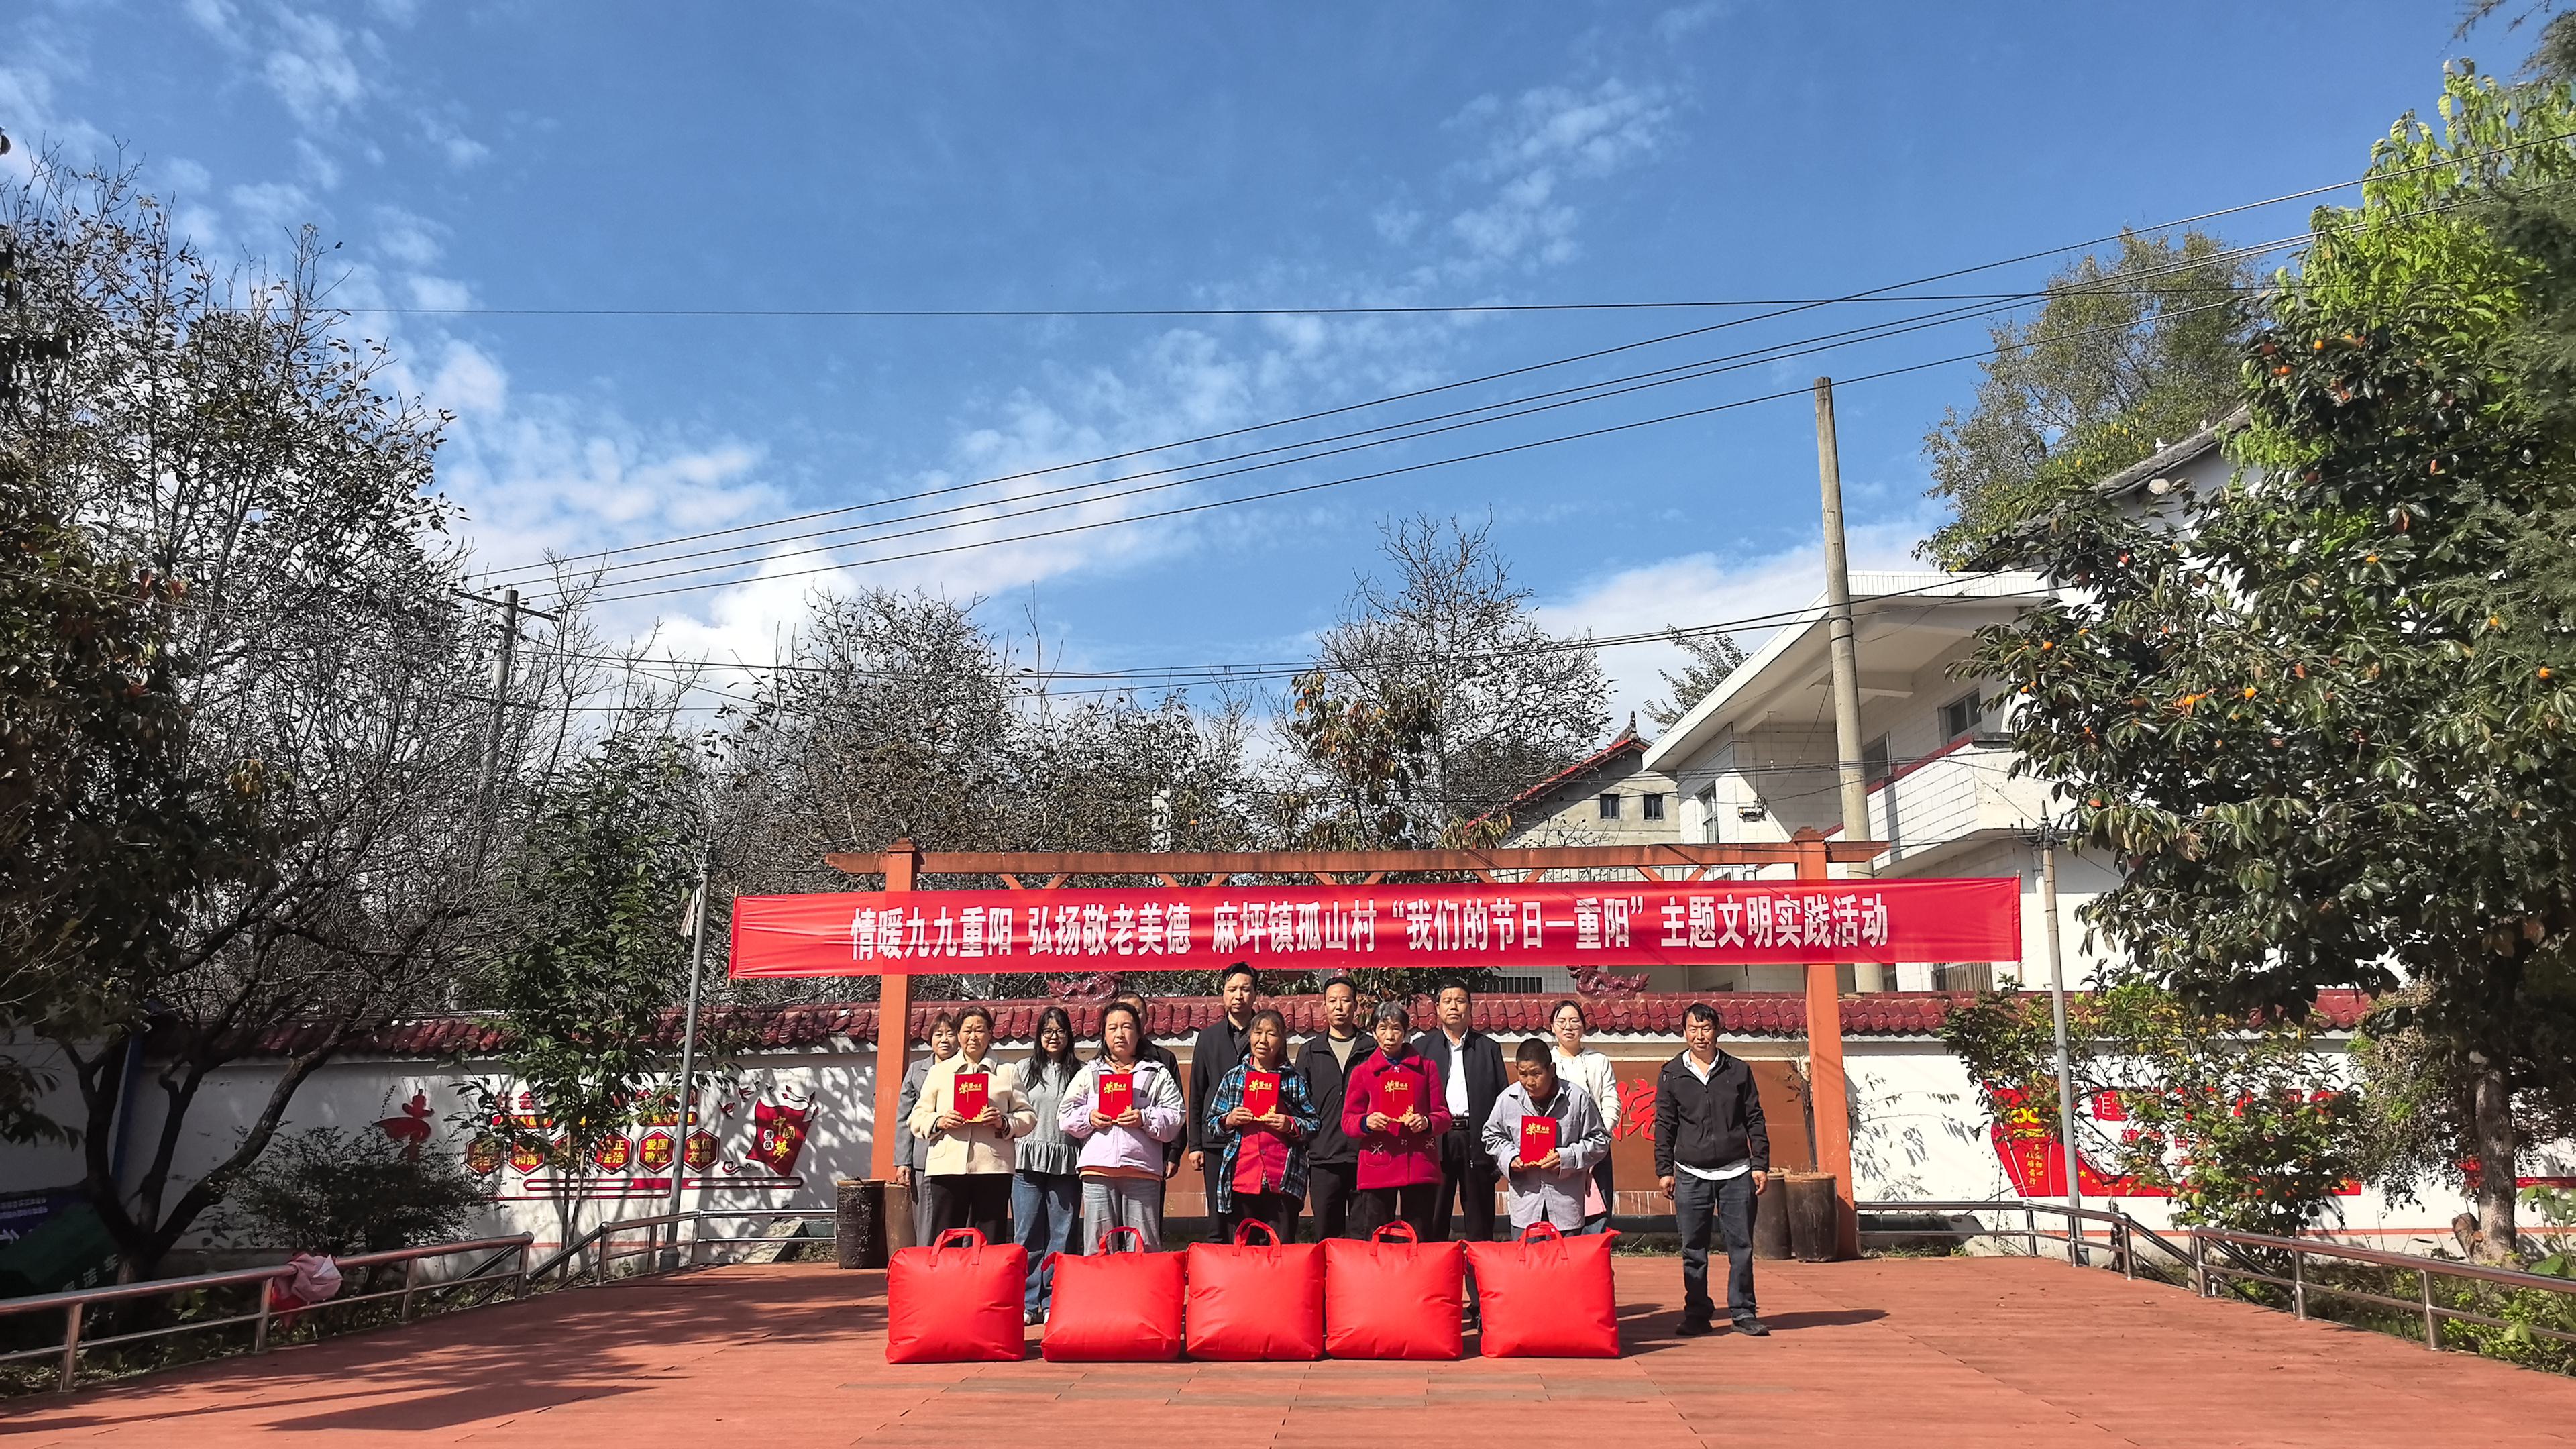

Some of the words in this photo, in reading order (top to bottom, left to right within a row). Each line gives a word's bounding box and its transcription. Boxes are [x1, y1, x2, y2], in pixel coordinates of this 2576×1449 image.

[850, 906, 1014, 961] 情暖九九重阳
[1028, 902, 1190, 956] 弘扬敬老美德
[1212, 900, 1376, 953] 麻坪镇孤山村
[1661, 893, 1887, 947] 主题文明实践活动
[1612, 1078, 1657, 1141] 院
[646, 1139, 669, 1150] 爱国
[689, 1139, 712, 1150] 诚信
[515, 1154, 537, 1165] 和谐
[600, 1152, 625, 1163] 法治
[645, 1152, 668, 1163] 敬业
[688, 1152, 711, 1163] 友善
